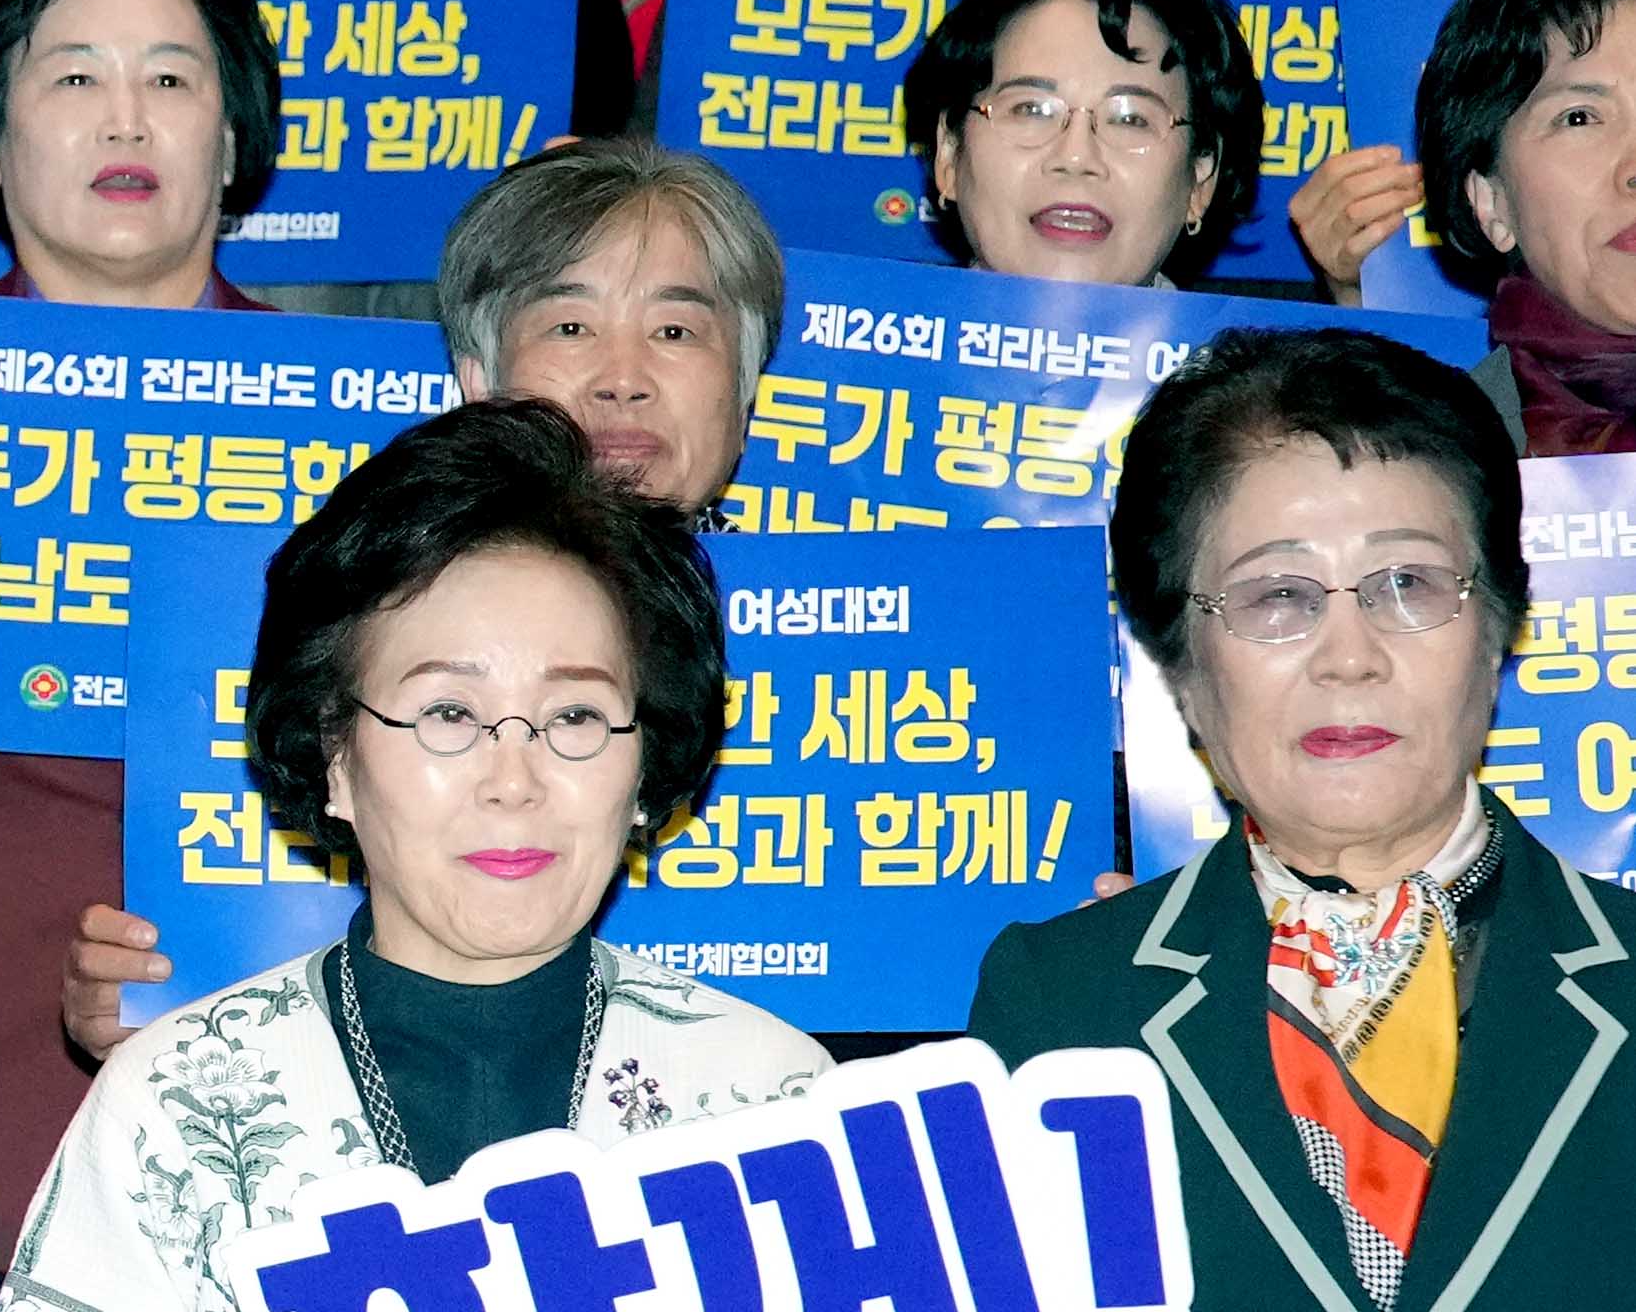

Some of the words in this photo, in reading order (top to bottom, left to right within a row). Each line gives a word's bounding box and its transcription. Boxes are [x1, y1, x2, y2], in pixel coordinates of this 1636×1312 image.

[324, 0, 480, 85] 세상,
[365, 95, 538, 172] 함께!
[801, 302, 946, 361] 제26회
[957, 319, 1136, 381] 전라남도
[141, 358, 317, 408] 전라남도
[728, 585, 910, 636] 여성대회
[800, 667, 996, 774] 세상,
[855, 790, 1072, 887] 함께!
